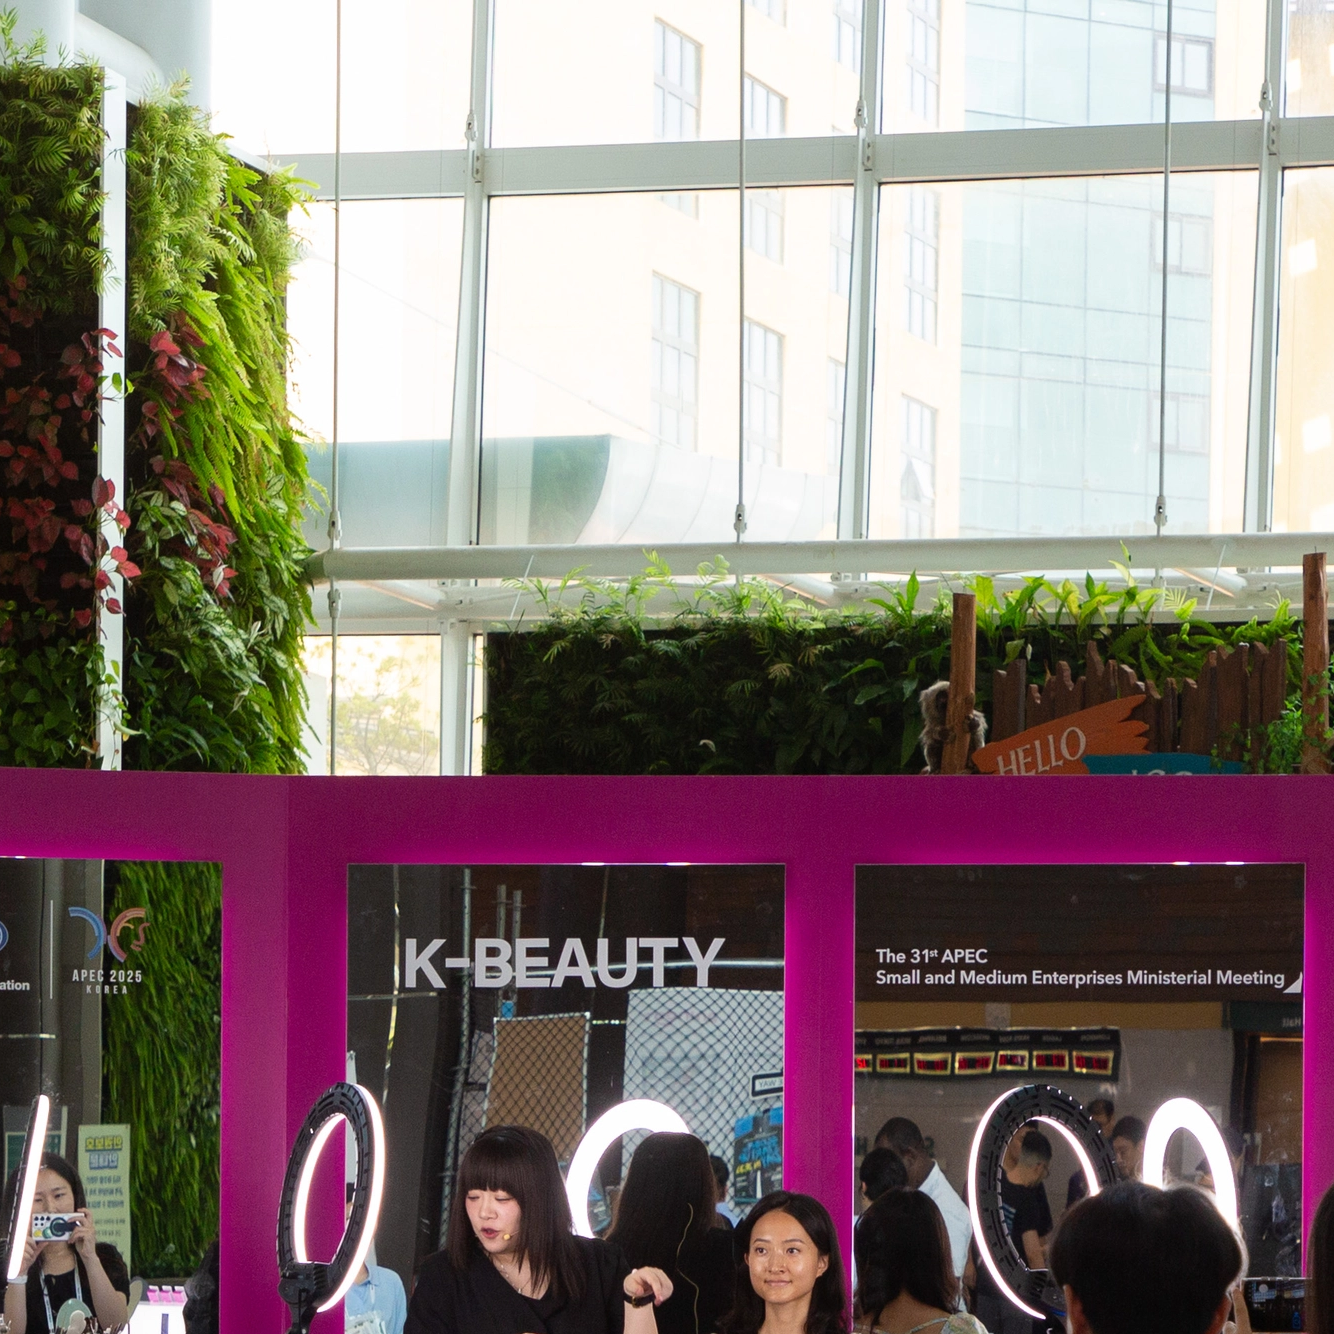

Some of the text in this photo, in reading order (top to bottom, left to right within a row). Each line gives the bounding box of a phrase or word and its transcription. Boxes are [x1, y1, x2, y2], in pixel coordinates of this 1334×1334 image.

[997, 727, 1087, 775] HELLO
[404, 937, 726, 988] K-BEAUTY
[876, 948, 988, 964] The 31st APEC
[72, 969, 142, 983] APEC 2025
[876, 969, 1285, 989] Small and Medium Enterprises Ministerial Meeting
[86, 985, 128, 994] KOREA
